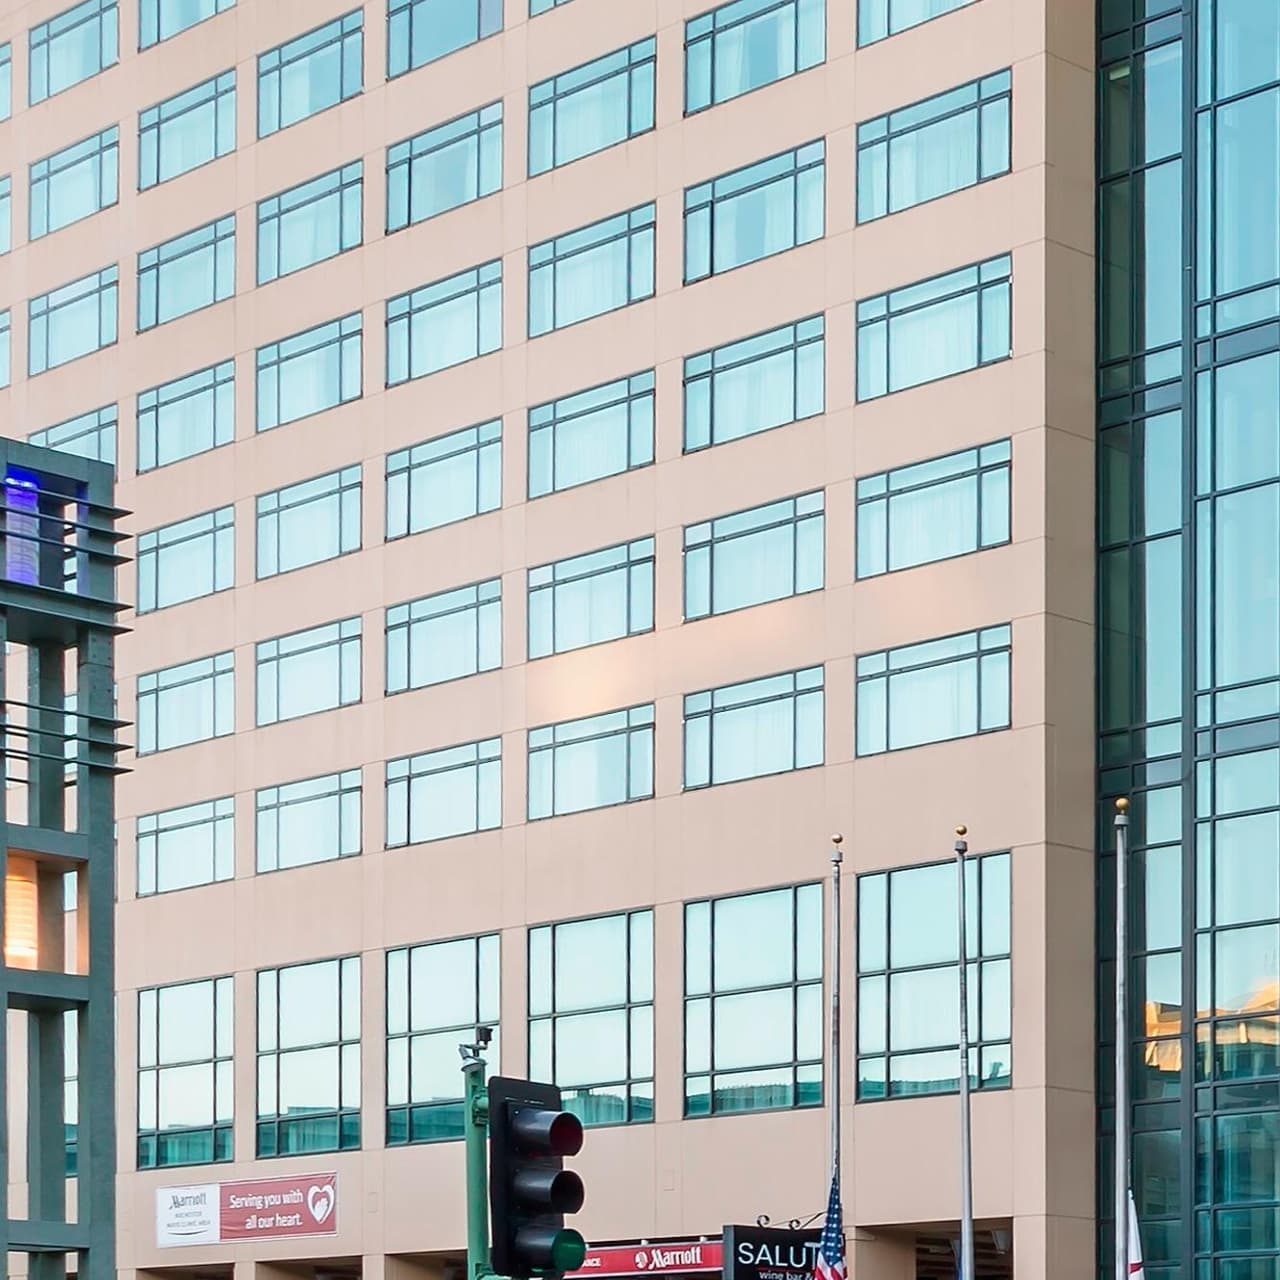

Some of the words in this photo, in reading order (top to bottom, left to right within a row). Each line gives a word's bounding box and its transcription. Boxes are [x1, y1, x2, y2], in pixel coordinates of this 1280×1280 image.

[168, 1192, 207, 1210] Marriott
[229, 1194, 263, 1210] Serving
[264, 1192, 282, 1209] you
[282, 1188, 304, 1203] with
[245, 1214, 258, 1230] all
[258, 1217, 275, 1229] our
[275, 1212, 304, 1227] heart.
[648, 1246, 703, 1270] Marriott
[738, 1242, 822, 1271] SALUT
[759, 1271, 783, 1280] wine
